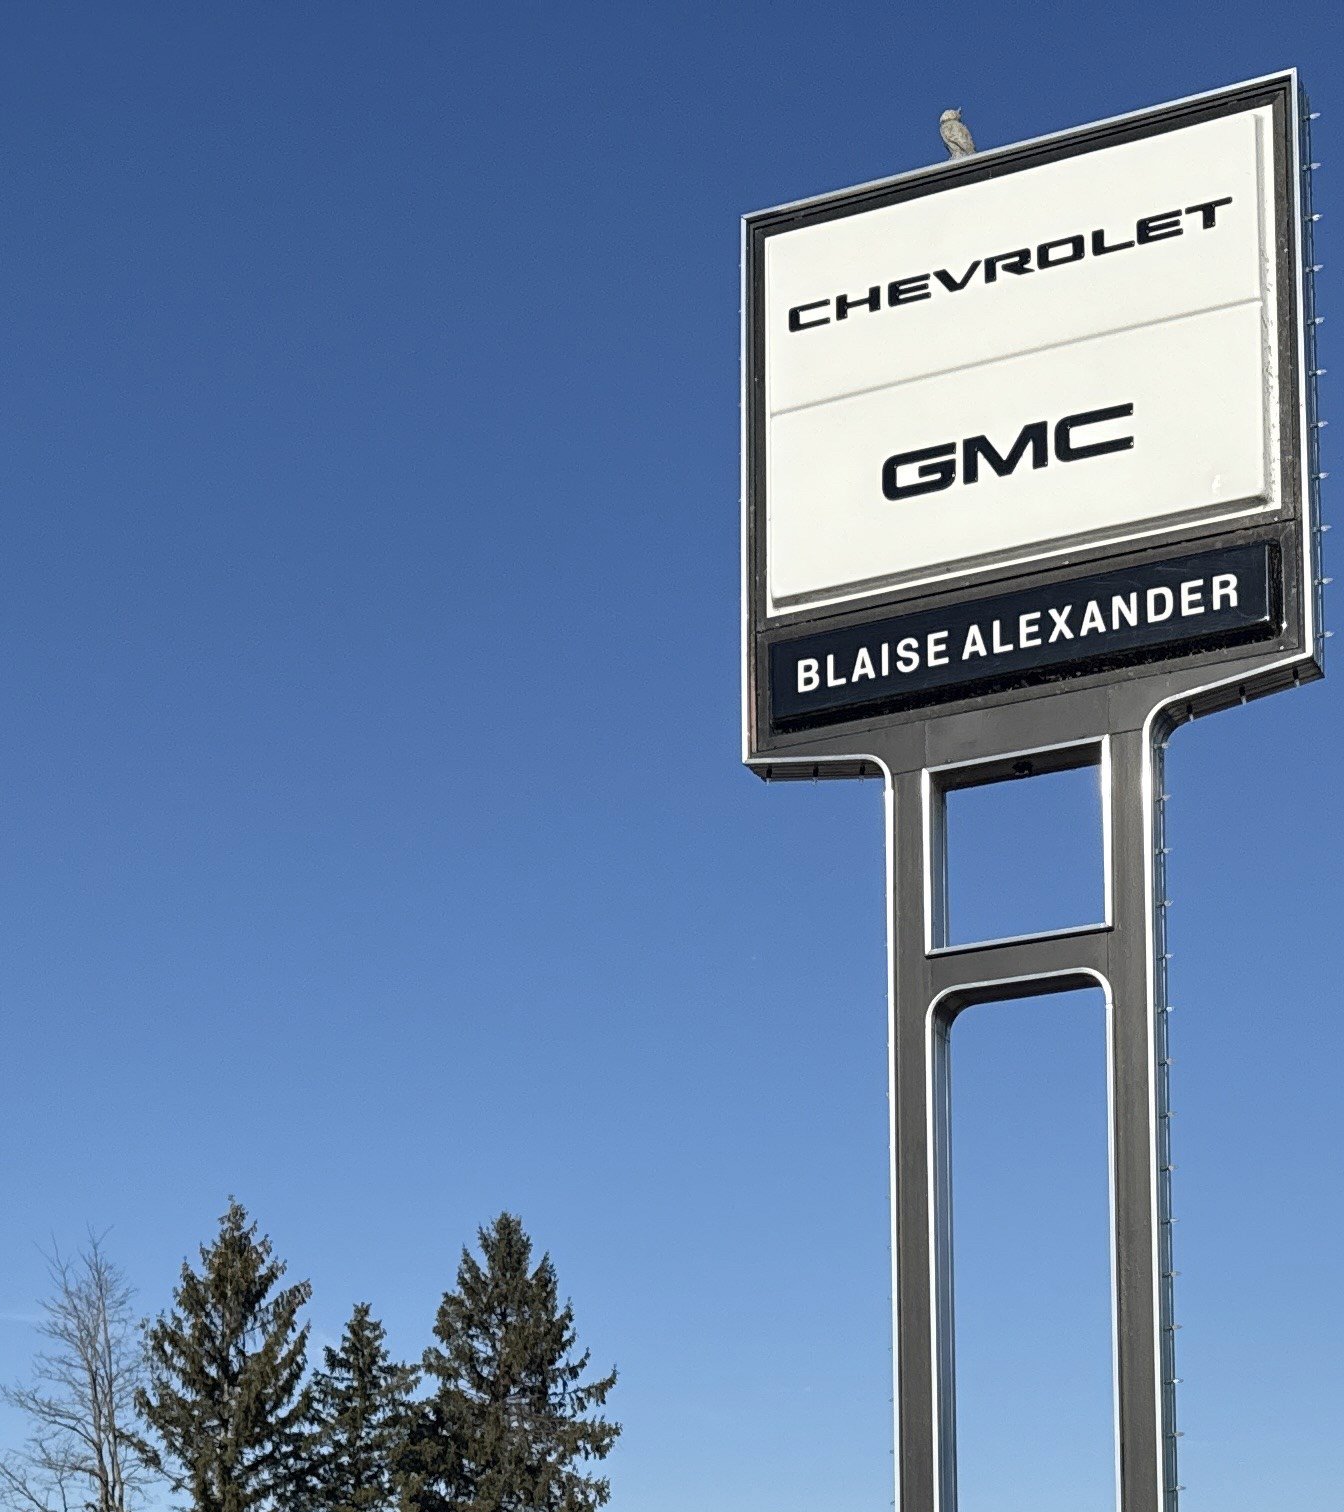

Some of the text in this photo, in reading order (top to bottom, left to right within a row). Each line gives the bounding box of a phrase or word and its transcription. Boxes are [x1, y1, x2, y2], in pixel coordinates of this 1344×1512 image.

[788, 196, 1233, 333] CHEVROLET
[881, 402, 1134, 501] GMC
[796, 572, 1239, 693] BLAISE ALEXANDER
